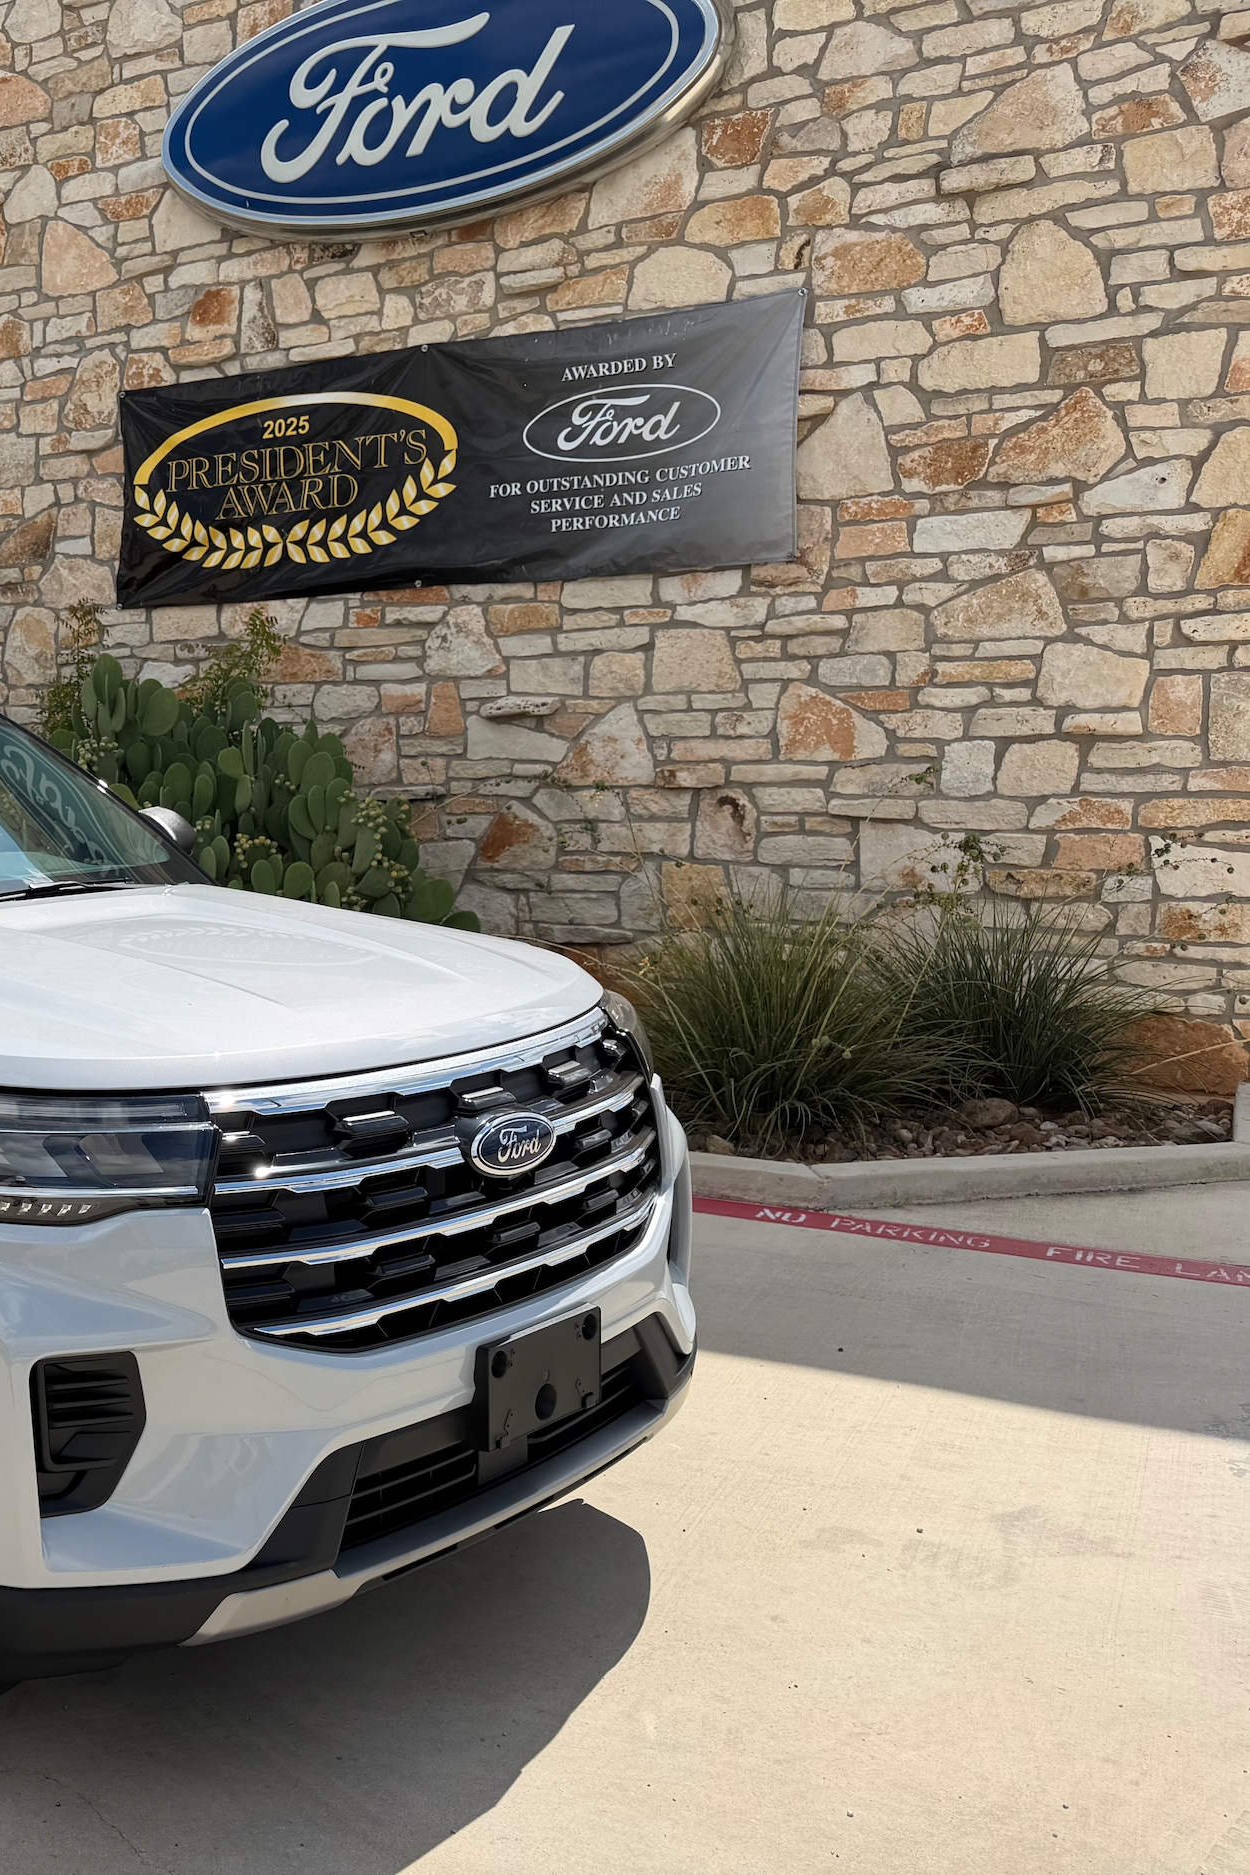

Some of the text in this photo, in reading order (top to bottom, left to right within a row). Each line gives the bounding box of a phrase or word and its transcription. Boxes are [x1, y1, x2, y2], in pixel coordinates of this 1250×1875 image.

[261, 12, 575, 183] Ford
[561, 353, 677, 382] AWARDED BY
[262, 416, 310, 440] 2025
[557, 394, 681, 451] Ford
[166, 429, 428, 493] PRESIDENT'S
[489, 455, 751, 498] FOR OUTSTANDING CUSTOMER
[215, 473, 359, 520] AWARD
[530, 482, 702, 514] SERVICE AND SALES
[551, 506, 681, 533] PERFORMANCE
[498, 1125, 541, 1163] Ford
[755, 1208, 807, 1223] NO
[830, 1217, 990, 1248] PARKING
[1046, 1246, 1141, 1269] FIRE
